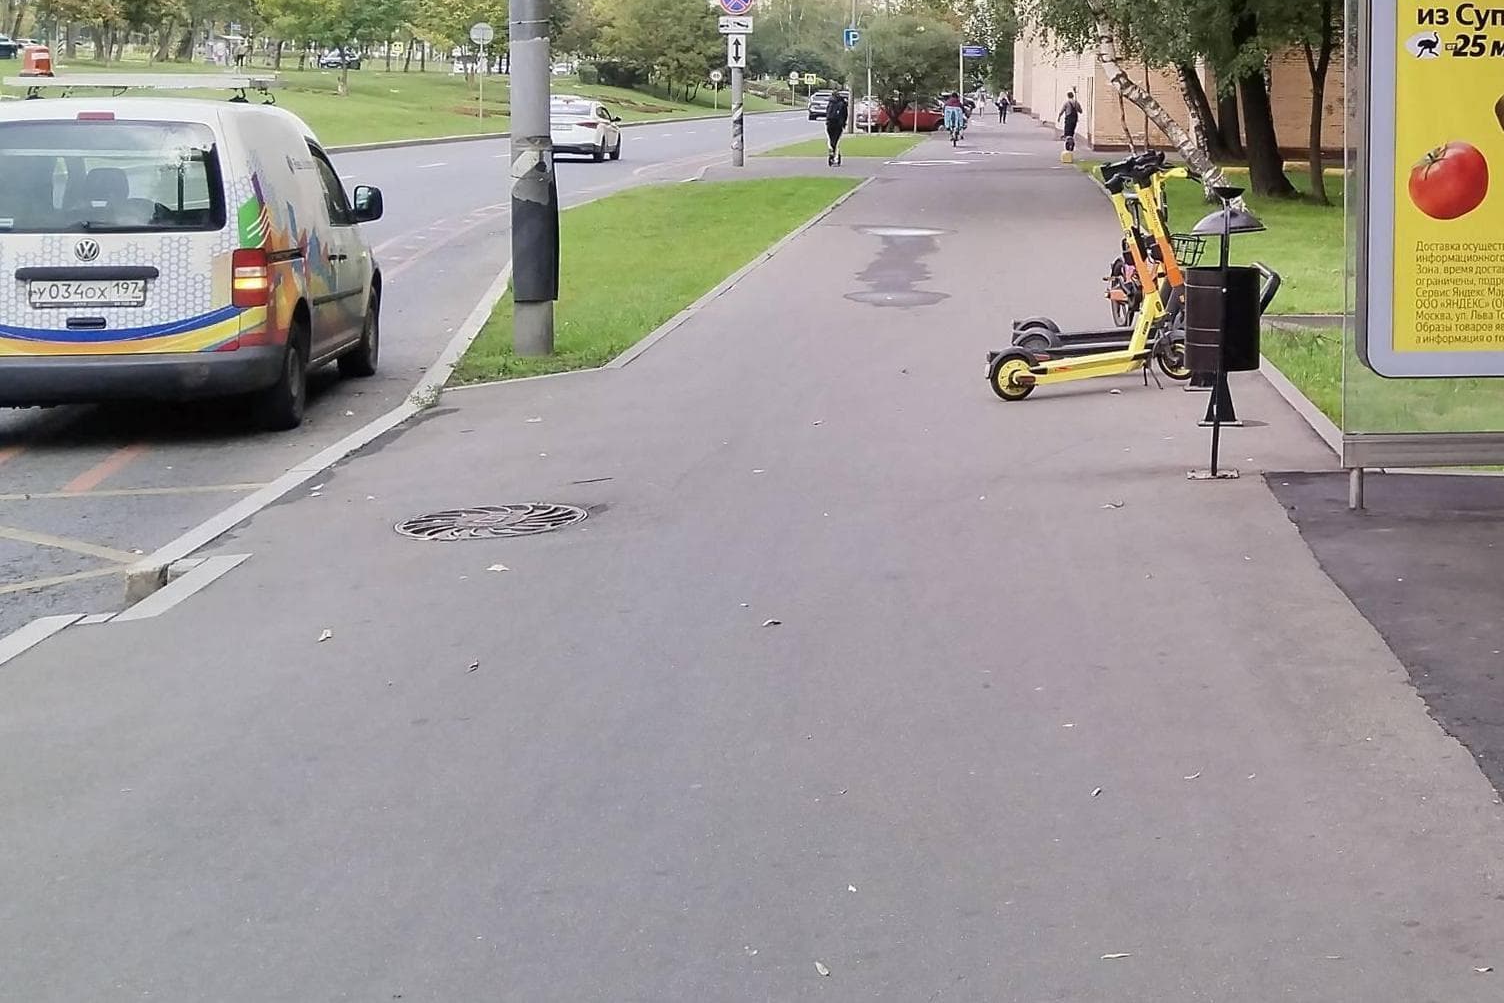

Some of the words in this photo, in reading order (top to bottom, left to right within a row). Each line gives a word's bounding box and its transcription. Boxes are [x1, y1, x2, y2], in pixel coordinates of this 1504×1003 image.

[1417, 7, 1449, 25] из
[1453, 34, 1487, 57] 25
[1416, 241, 1460, 252] Доставка
[1444, 266, 1473, 274] время
[112, 281, 139, 295] 197
[1416, 287, 1450, 298] Сервис
[1452, 287, 1485, 298] Яндекс
[1416, 299, 1437, 309] ООО
[1470, 310, 1493, 321] Льва
[1416, 322, 1452, 332] Образы
[1455, 324, 1493, 333] товаров
[1423, 333, 1484, 345] информация
